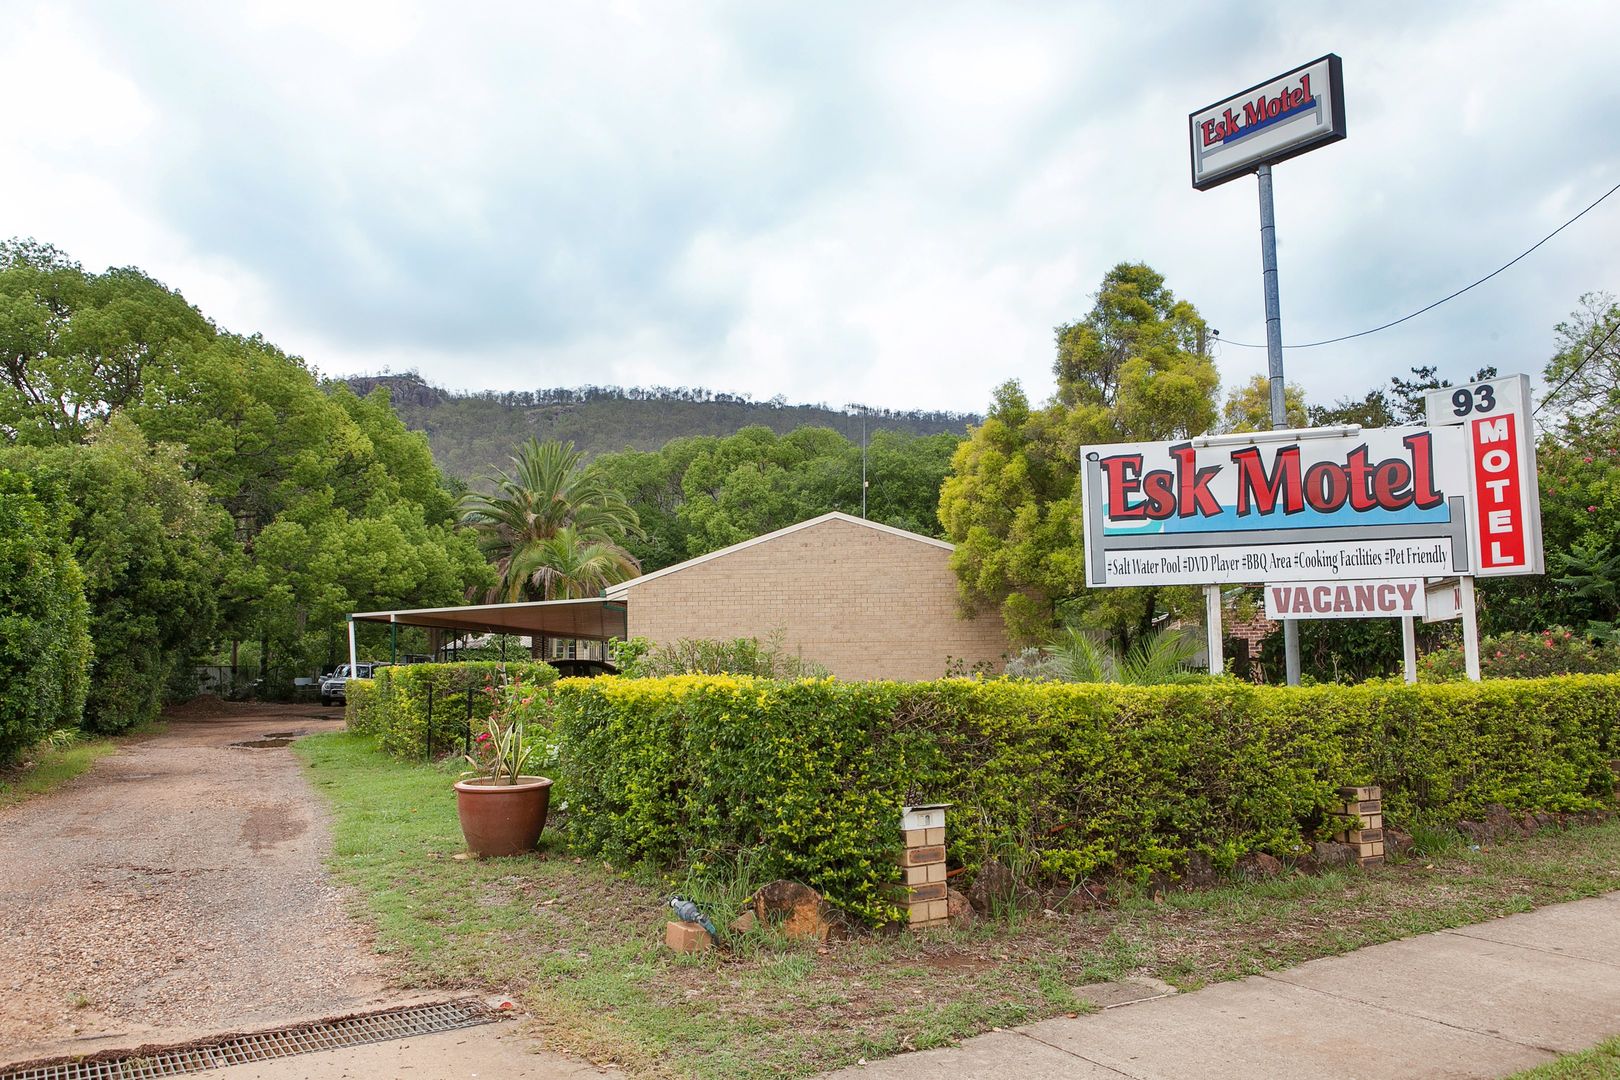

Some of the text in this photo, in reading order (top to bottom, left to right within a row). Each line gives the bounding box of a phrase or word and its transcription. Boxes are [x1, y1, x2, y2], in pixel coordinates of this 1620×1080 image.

[1201, 73, 1315, 147] Esk Motel
[1451, 384, 1497, 417] 93
[1101, 431, 1445, 522] Esk Motel
[1479, 417, 1515, 565] MOTEL
[1132, 558, 1159, 575] Water
[1160, 555, 1181, 574] Pool
[1210, 553, 1240, 578] Player
[1269, 552, 1292, 569] Area
[1340, 547, 1382, 567] Facilities
[1406, 544, 1448, 570] Friendly
[1272, 583, 1417, 614] VACANCY
